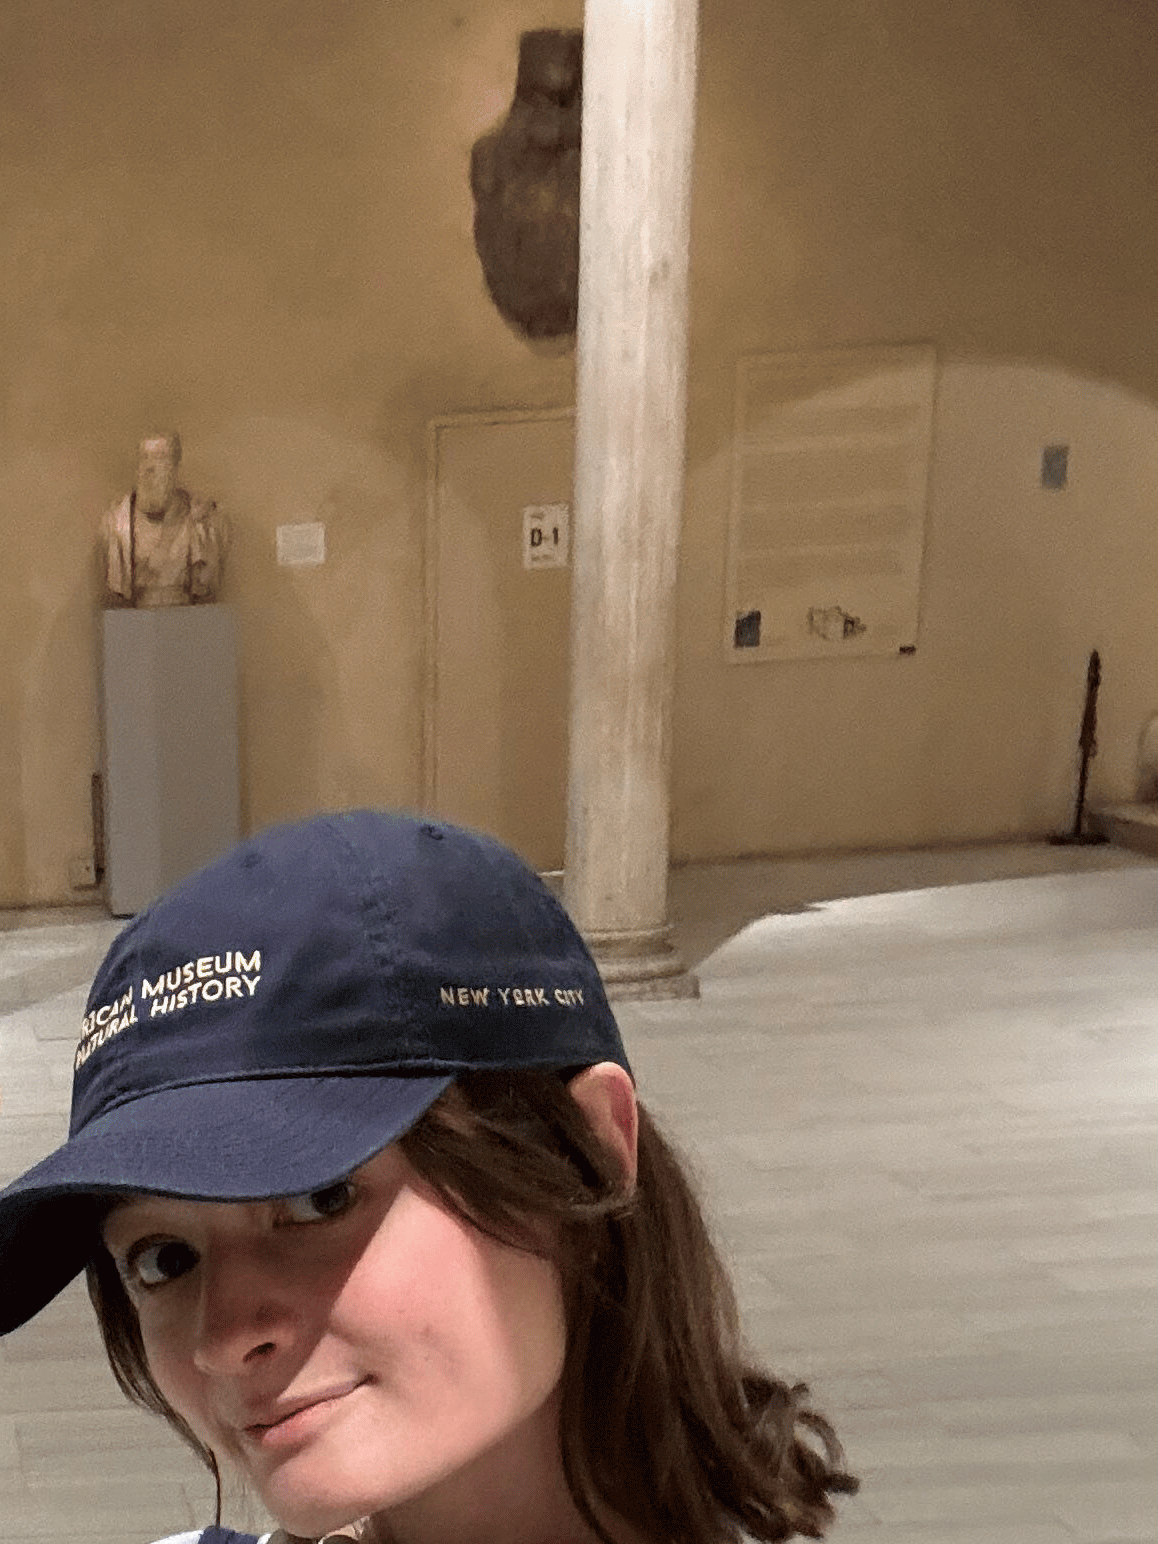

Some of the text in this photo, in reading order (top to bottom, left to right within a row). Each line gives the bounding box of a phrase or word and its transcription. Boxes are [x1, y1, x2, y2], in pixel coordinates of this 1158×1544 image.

[141, 950, 262, 999] MUSEUM
[150, 975, 261, 1018] HISTORY
[440, 986, 585, 1007] NEW YORK CITY
